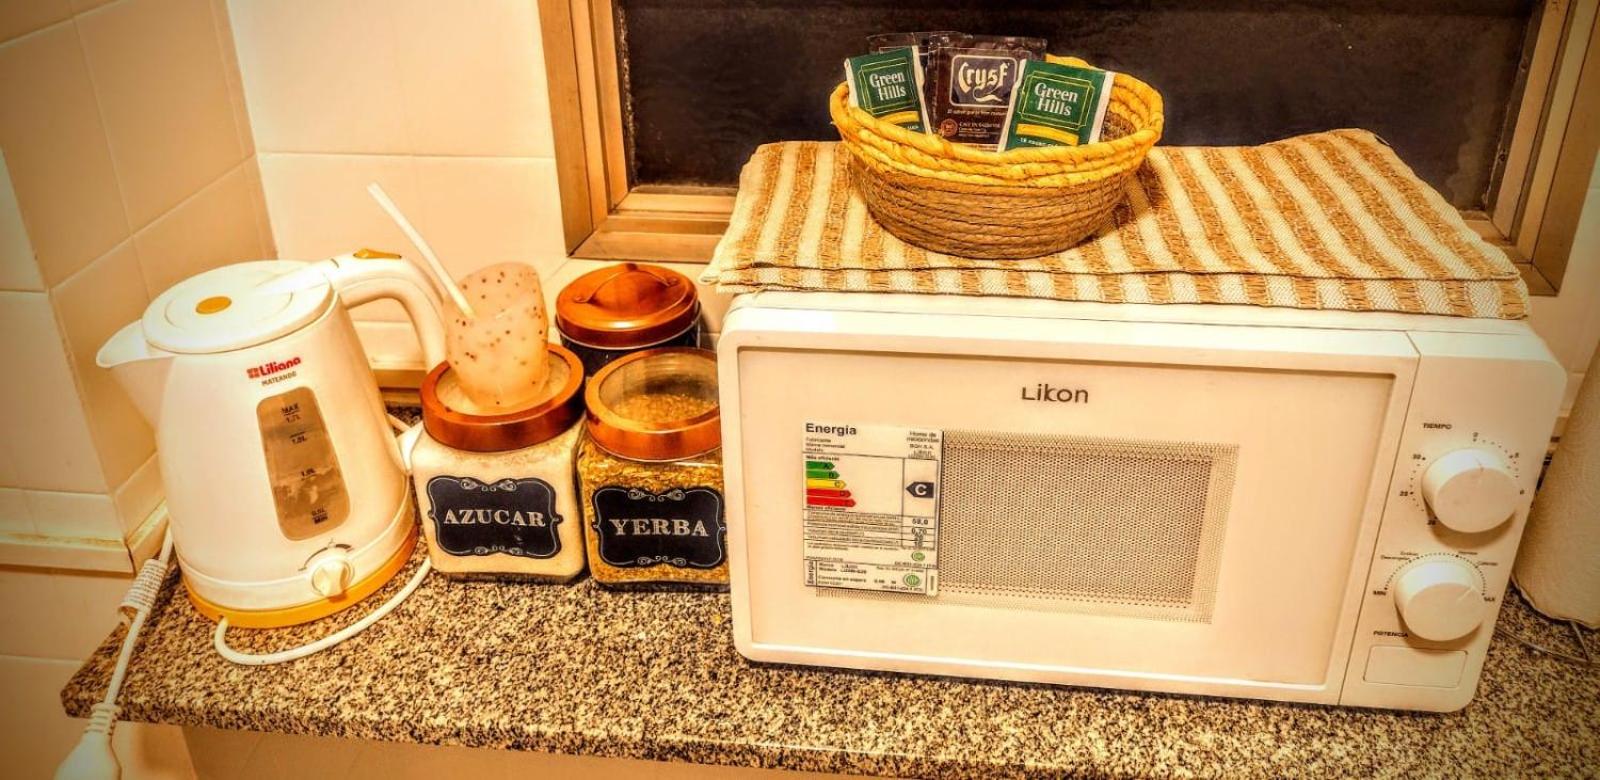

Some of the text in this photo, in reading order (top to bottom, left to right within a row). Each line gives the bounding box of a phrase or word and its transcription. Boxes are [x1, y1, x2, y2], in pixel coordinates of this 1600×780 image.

[869, 70, 906, 88] Green
[878, 85, 907, 101] Hills
[1034, 82, 1079, 103] Green
[1036, 98, 1073, 117] Hills
[259, 356, 301, 376] Liliana
[1021, 383, 1089, 403] Likon
[281, 404, 300, 415] MAX
[1423, 422, 1453, 431] TIEMPO
[834, 480, 841, 488] C
[915, 483, 927, 496] C
[444, 508, 546, 528] AZUCAR
[610, 517, 710, 538] YERBA
[1372, 589, 1386, 597] MIN
